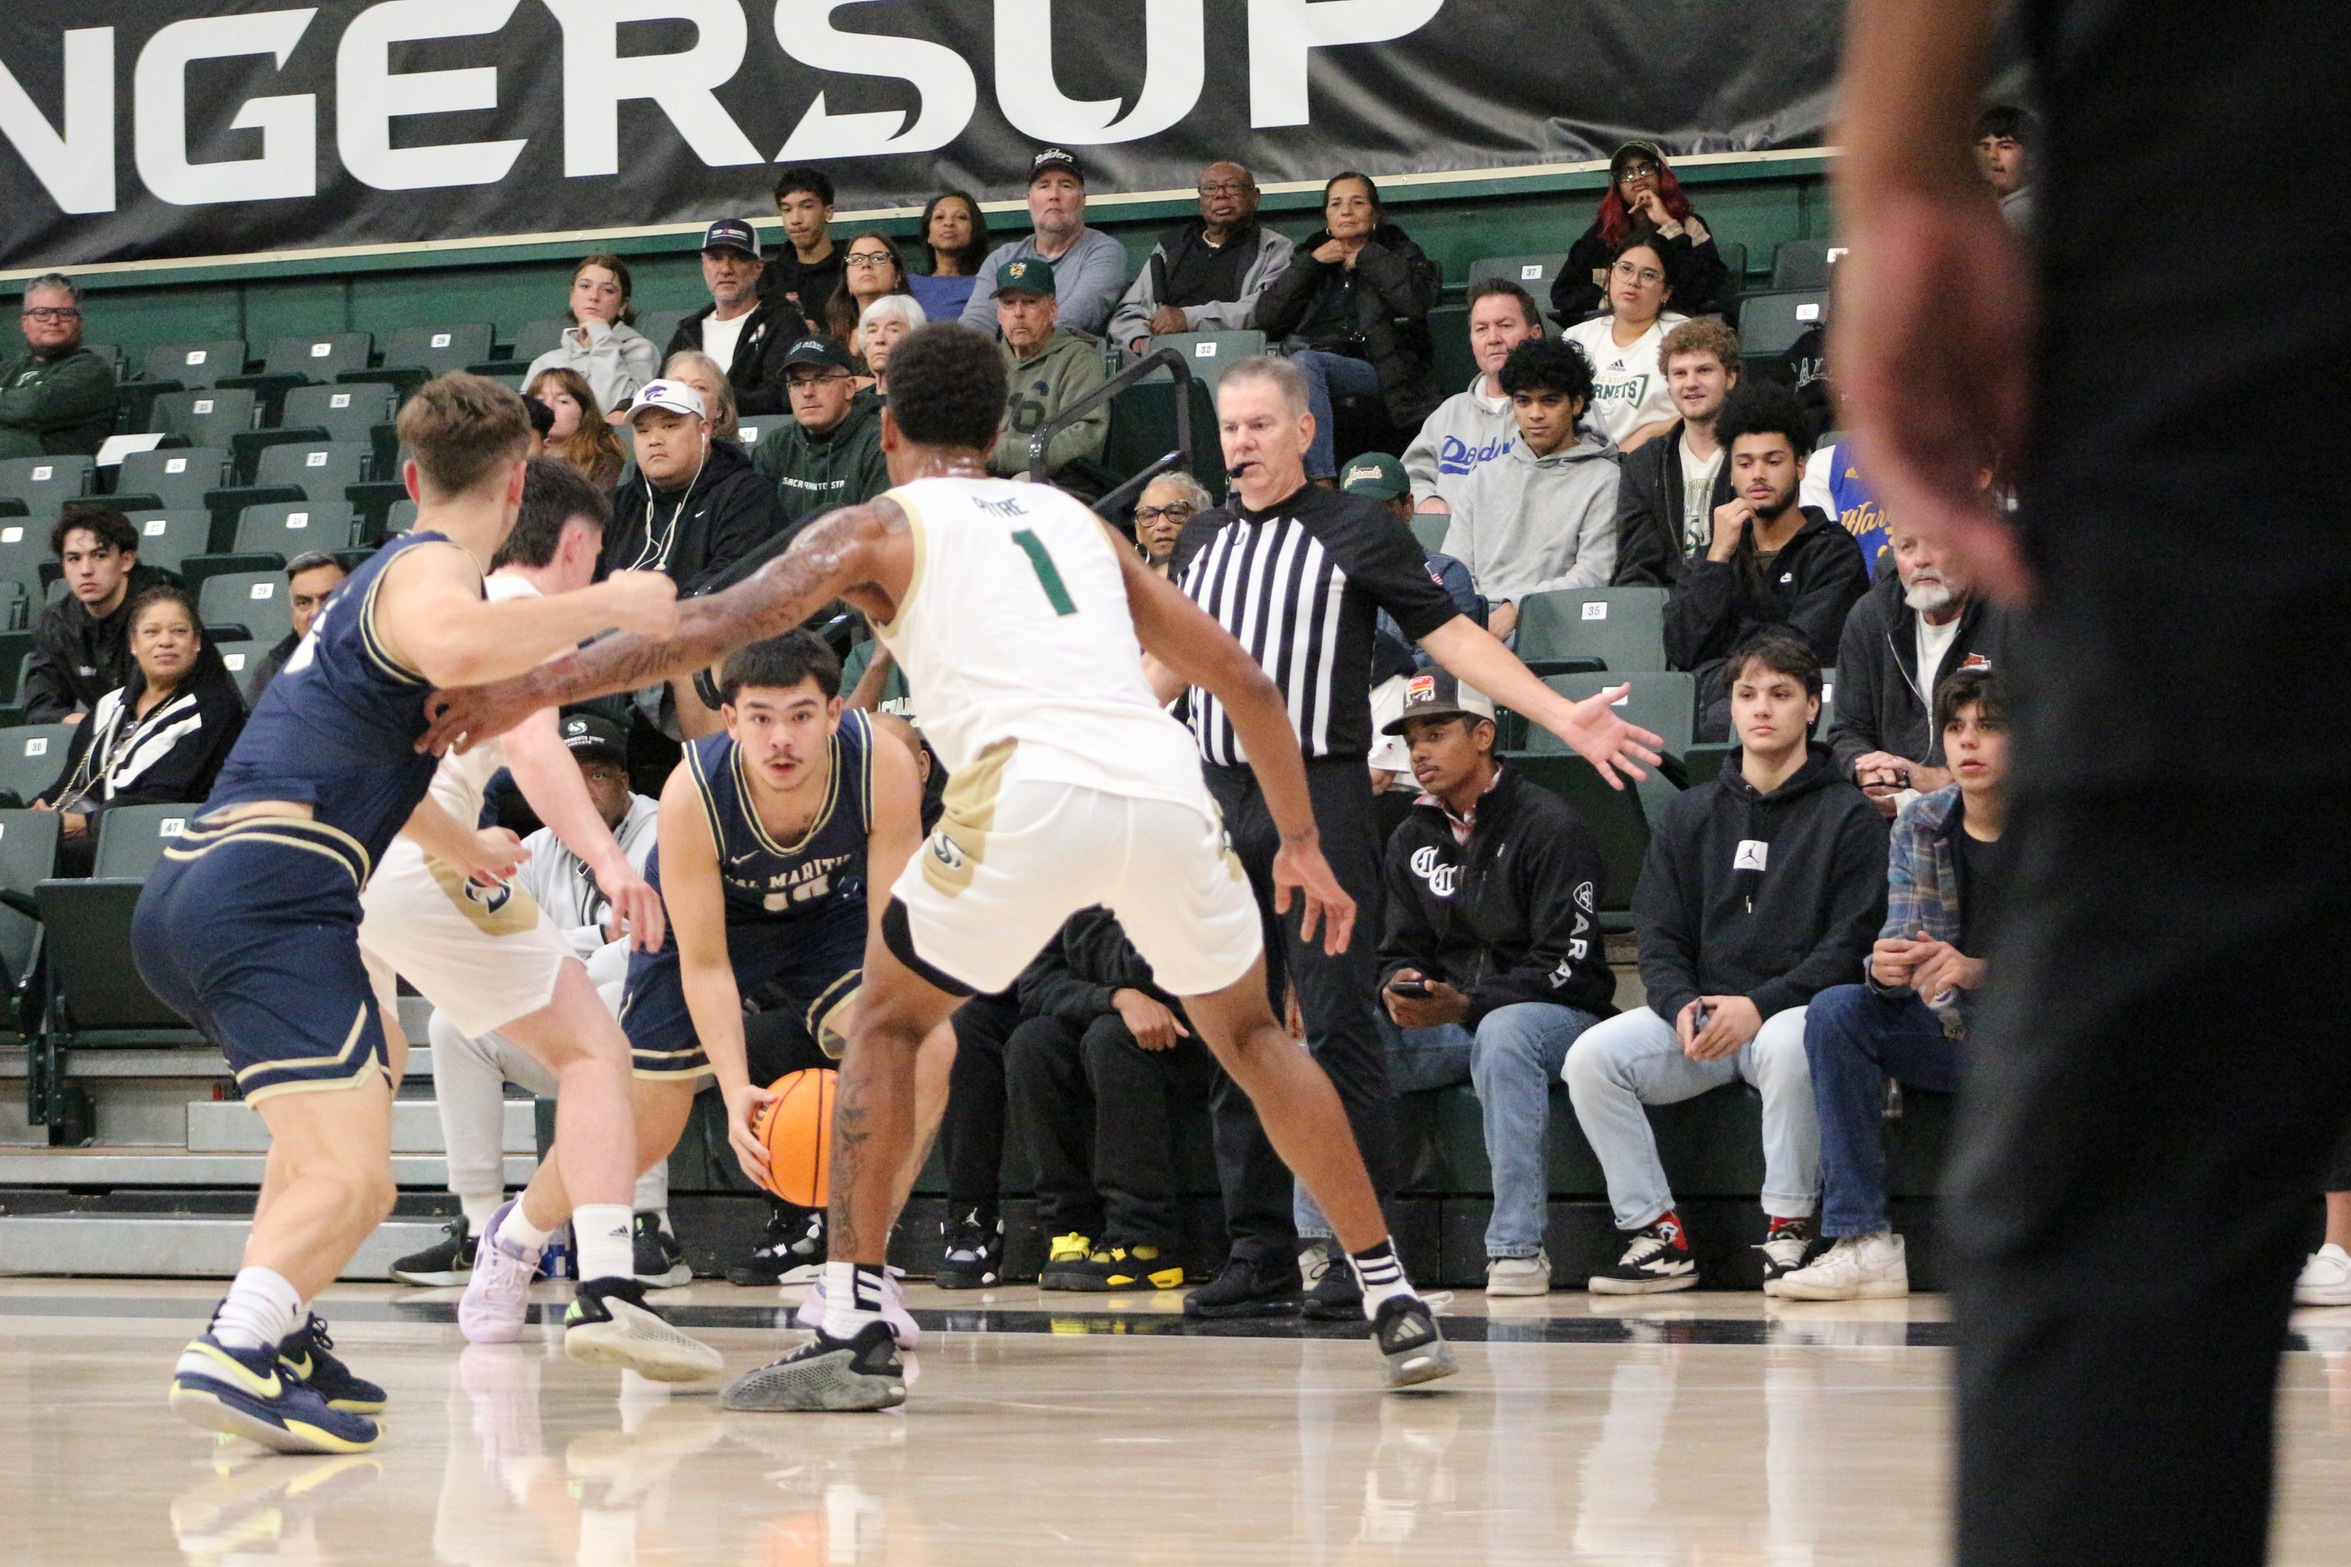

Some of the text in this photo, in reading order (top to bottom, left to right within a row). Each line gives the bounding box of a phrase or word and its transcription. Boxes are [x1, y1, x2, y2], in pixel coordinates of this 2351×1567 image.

[0, 0, 1445, 214] NGERSUP
[1034, 147, 1074, 166] Raiders
[1526, 267, 1537, 277] 37
[1200, 345, 1212, 355] 32
[1593, 380, 1638, 400] RNETS
[1011, 528, 1079, 617] 1
[1587, 605, 1601, 617] 35
[31, 742, 43, 752] 30
[166, 822, 180, 833] 47
[1548, 911, 1589, 989] ARAT
